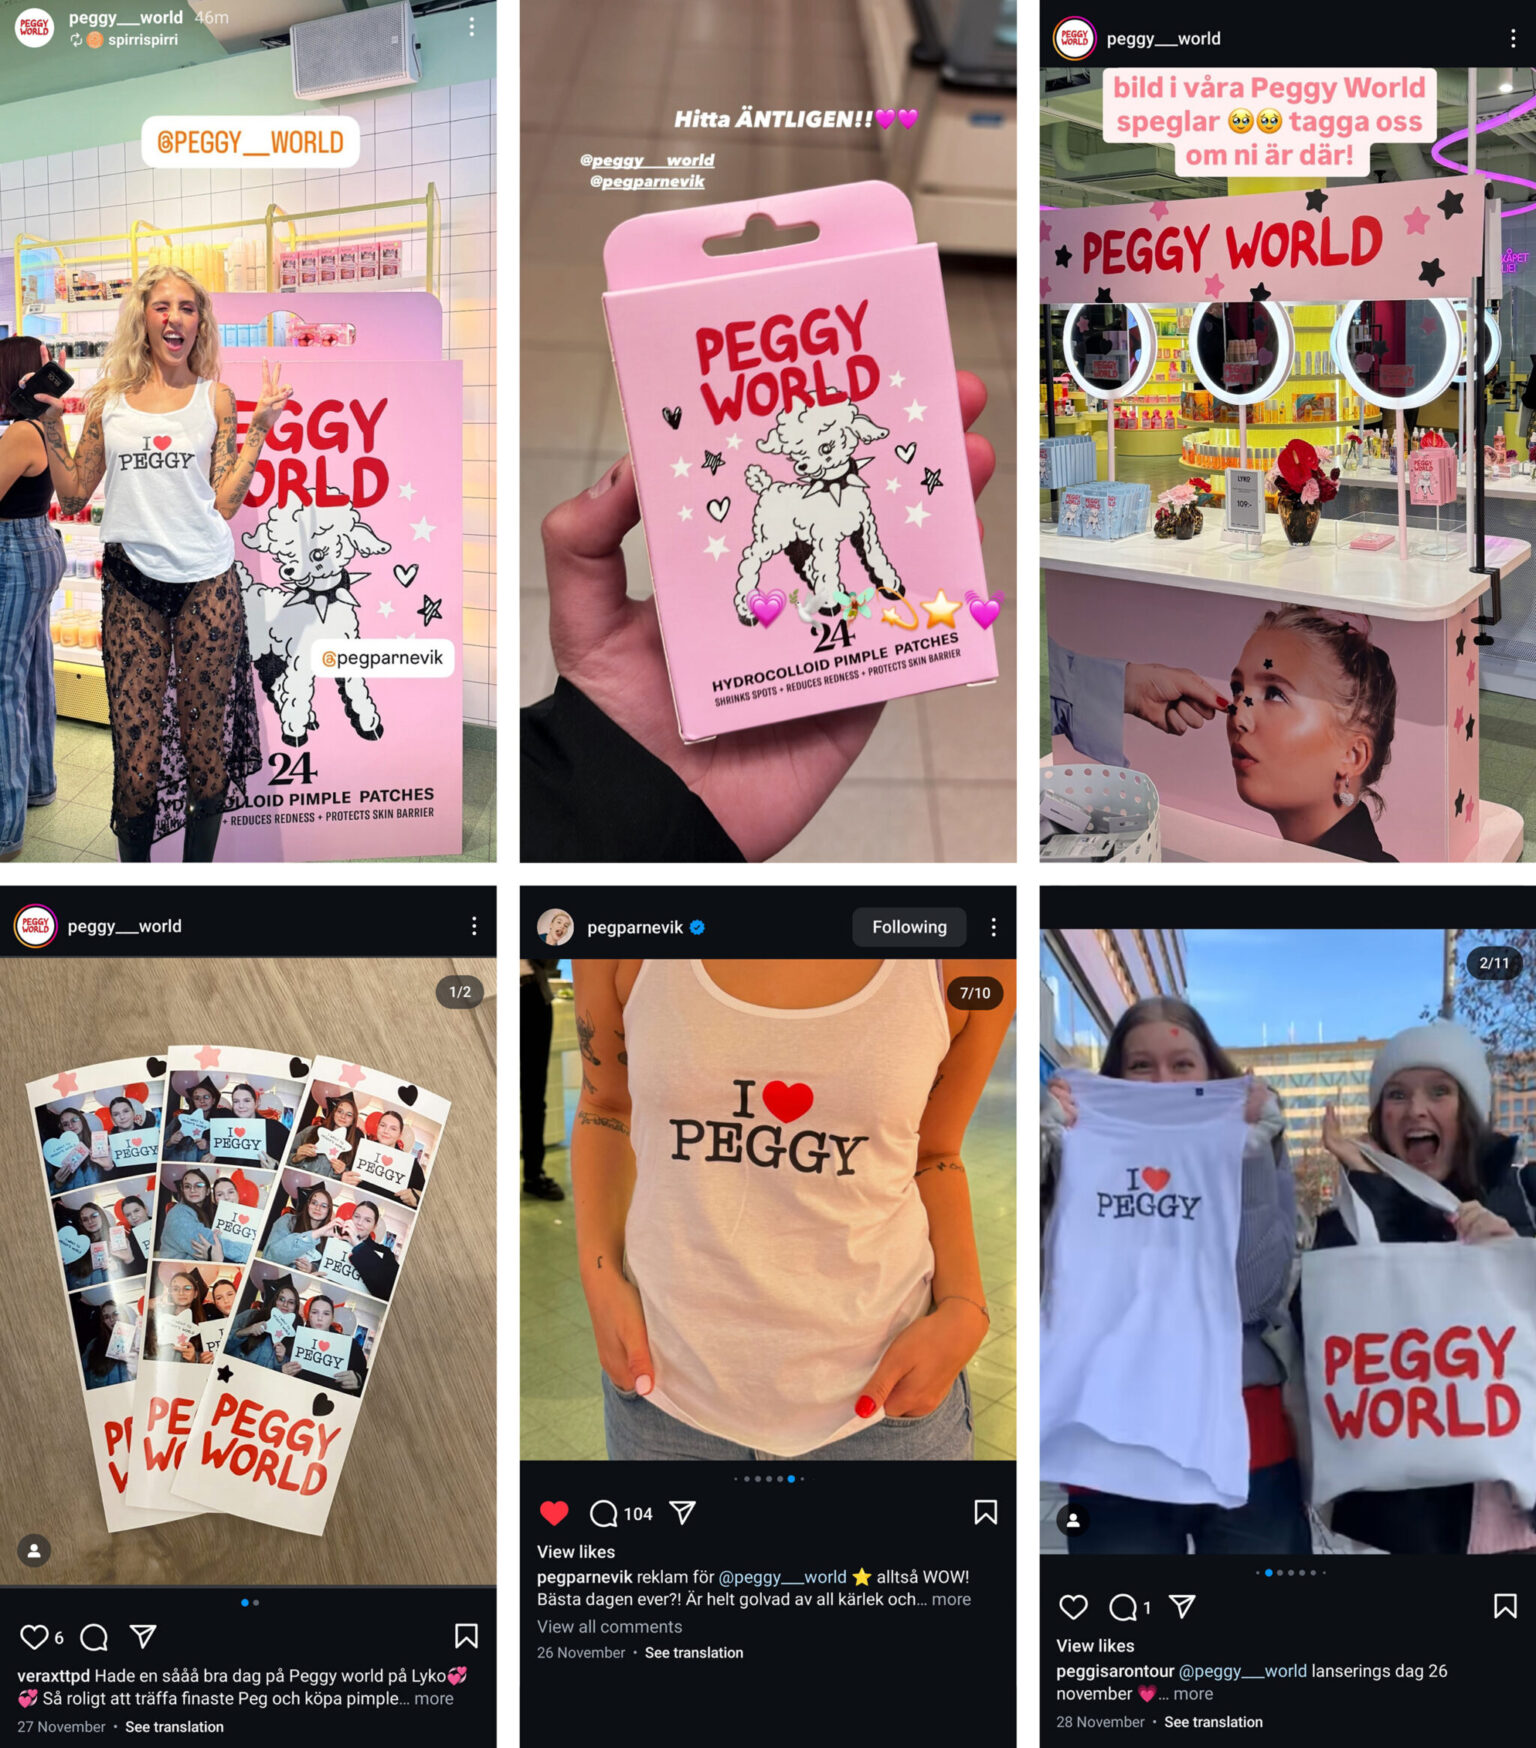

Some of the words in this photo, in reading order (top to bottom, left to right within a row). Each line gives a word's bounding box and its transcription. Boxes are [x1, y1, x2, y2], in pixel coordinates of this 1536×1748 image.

[1083, 223, 1211, 275] PEGGY
[1225, 215, 1383, 270] WORLD
[696, 299, 868, 375] PEGGY
[700, 354, 880, 425] WORLD
[236, 398, 388, 454] EGGY
[142, 436, 151, 451] I
[118, 453, 195, 471] PEGGY
[242, 455, 389, 509] ORLD
[811, 619, 856, 654] 24
[712, 658, 830, 692] HYDROCOLLOID
[834, 647, 888, 668] PIMPLE
[894, 632, 959, 656] PATCHES
[715, 694, 750, 707] SHRINKS
[752, 686, 777, 702] SPOTS
[786, 677, 822, 693] REDUCES
[824, 669, 859, 685] REDNESS
[868, 660, 907, 677] PROTECTS
[908, 655, 927, 668] SKIN
[928, 648, 962, 664] BARRIER
[268, 752, 318, 786] 24
[290, 792, 350, 806] PIMPLE
[360, 788, 434, 802] PATCHES
[231, 814, 271, 825] REDUCES
[275, 813, 315, 824] REDNESS
[326, 810, 370, 822] PROTECTS
[373, 809, 394, 820] SKIN
[397, 807, 434, 818] BARRIER
[733, 1079, 756, 1119] I
[126, 1139, 131, 1148] I
[214, 1138, 261, 1150] PEGGY
[228, 1127, 233, 1137] I
[115, 1145, 158, 1160] PEGGY
[374, 1153, 381, 1163] I
[669, 1118, 869, 1176] PEGGY
[357, 1159, 406, 1184] PEGGY
[1126, 1168, 1139, 1191] I
[231, 1212, 238, 1222] I
[1097, 1191, 1201, 1220] PEGGY
[324, 1257, 361, 1281] PEGG
[340, 1251, 347, 1262] I
[311, 1338, 317, 1350] I
[1324, 1325, 1516, 1386] PEGGY
[295, 1346, 345, 1370] PEGGY
[1324, 1383, 1521, 1440] WORLD
[211, 1393, 341, 1460] PEGGY
[201, 1430, 328, 1496] WORLD
